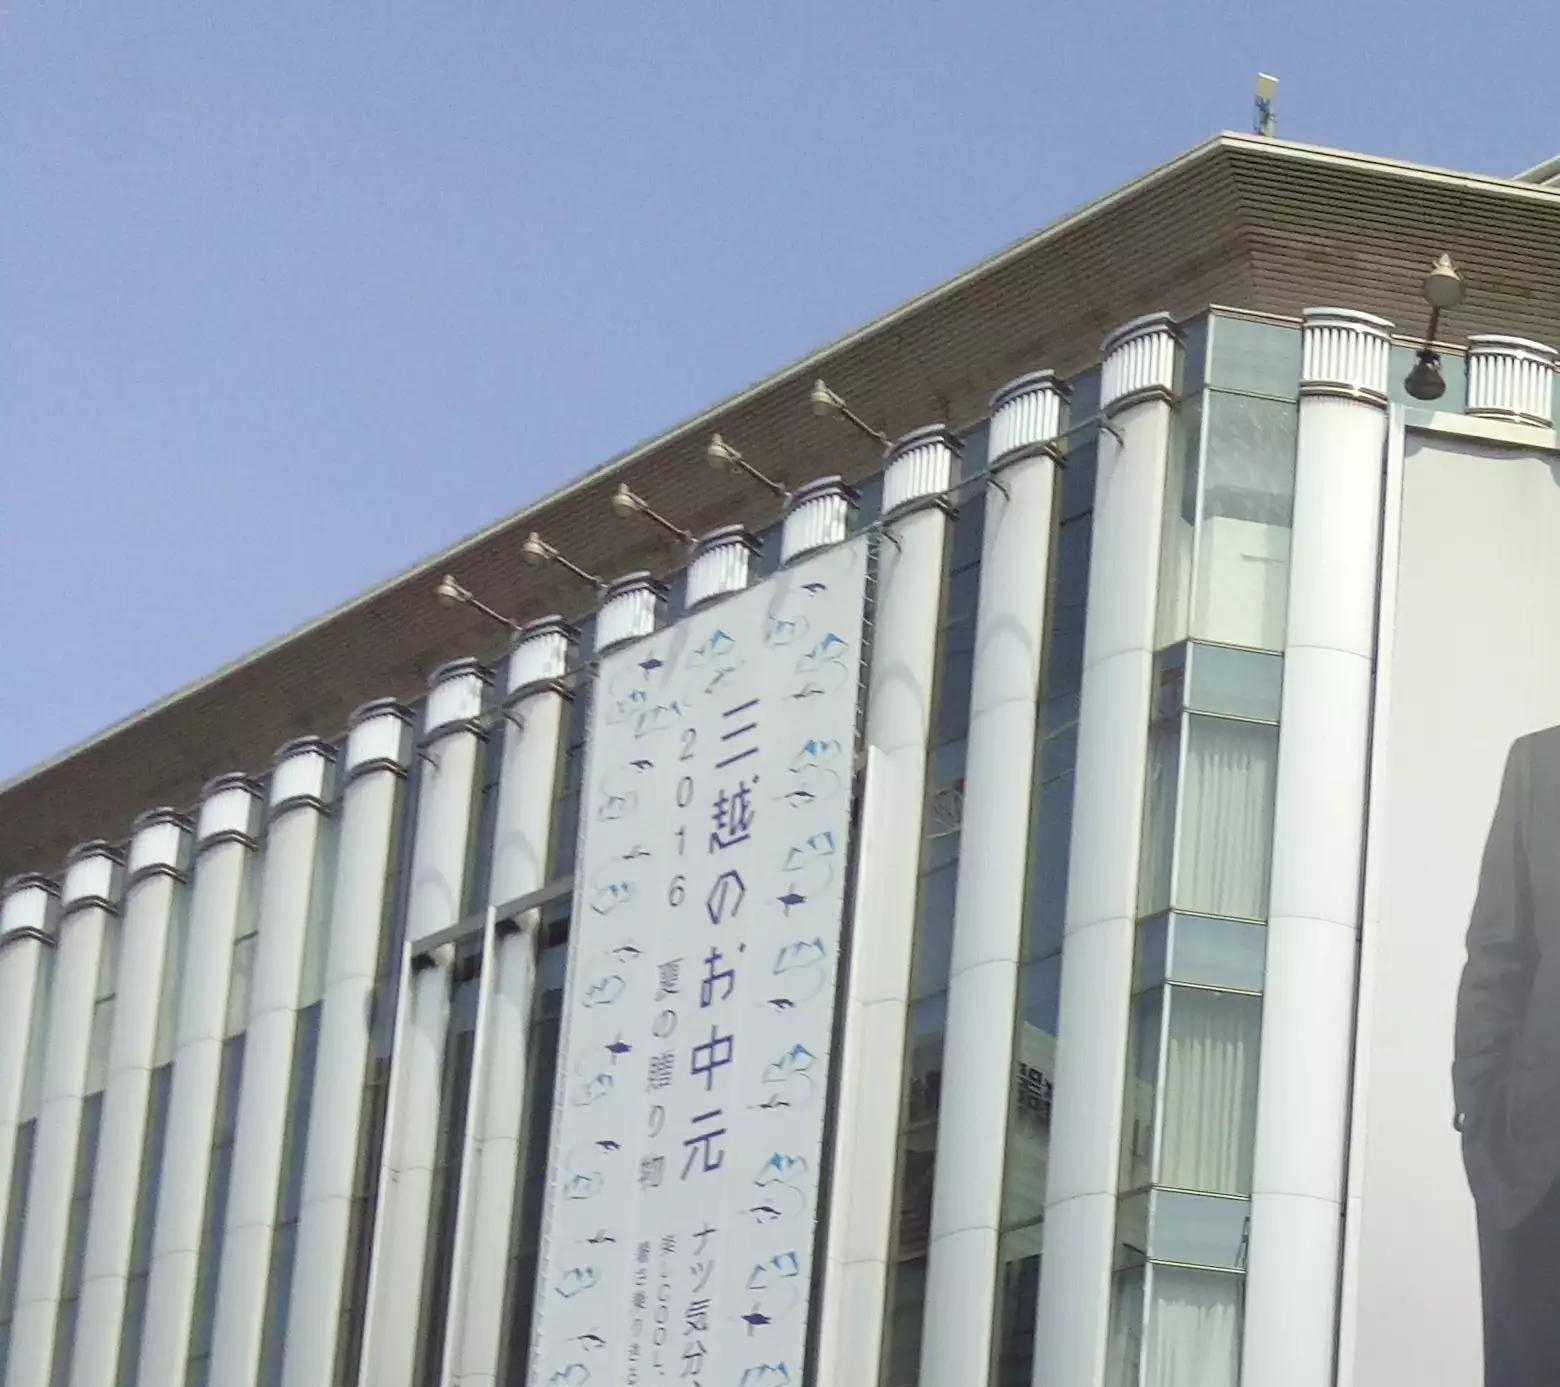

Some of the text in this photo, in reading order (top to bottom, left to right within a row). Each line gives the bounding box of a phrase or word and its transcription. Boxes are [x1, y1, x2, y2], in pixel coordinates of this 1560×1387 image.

[667, 727, 698, 908] 2016
[680, 697, 761, 1181] 三越のお中元
